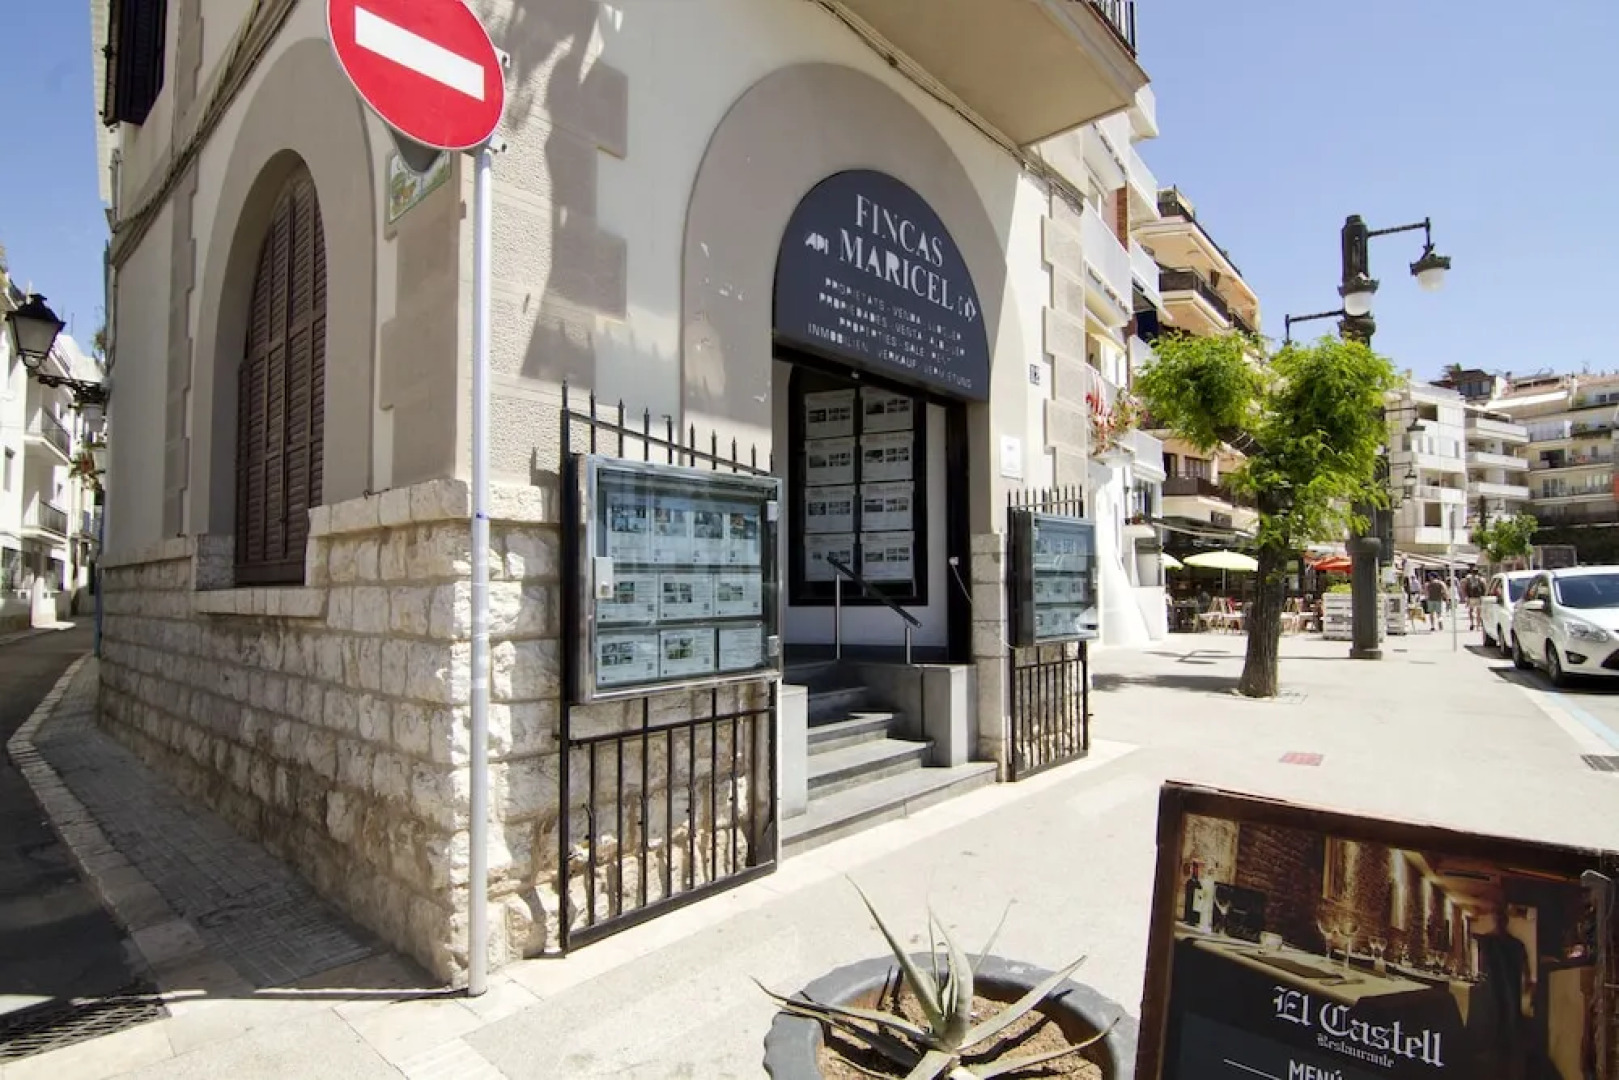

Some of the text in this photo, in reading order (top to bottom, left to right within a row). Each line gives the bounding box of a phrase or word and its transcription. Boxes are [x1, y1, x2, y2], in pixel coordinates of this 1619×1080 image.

[855, 193, 943, 268] FINCAS
[840, 227, 953, 311] MARICEL
[903, 341, 925, 357] SALE
[927, 320, 962, 341] LLOGER
[923, 364, 972, 389] VERMETUNG
[1272, 985, 1445, 1067] El Castell
